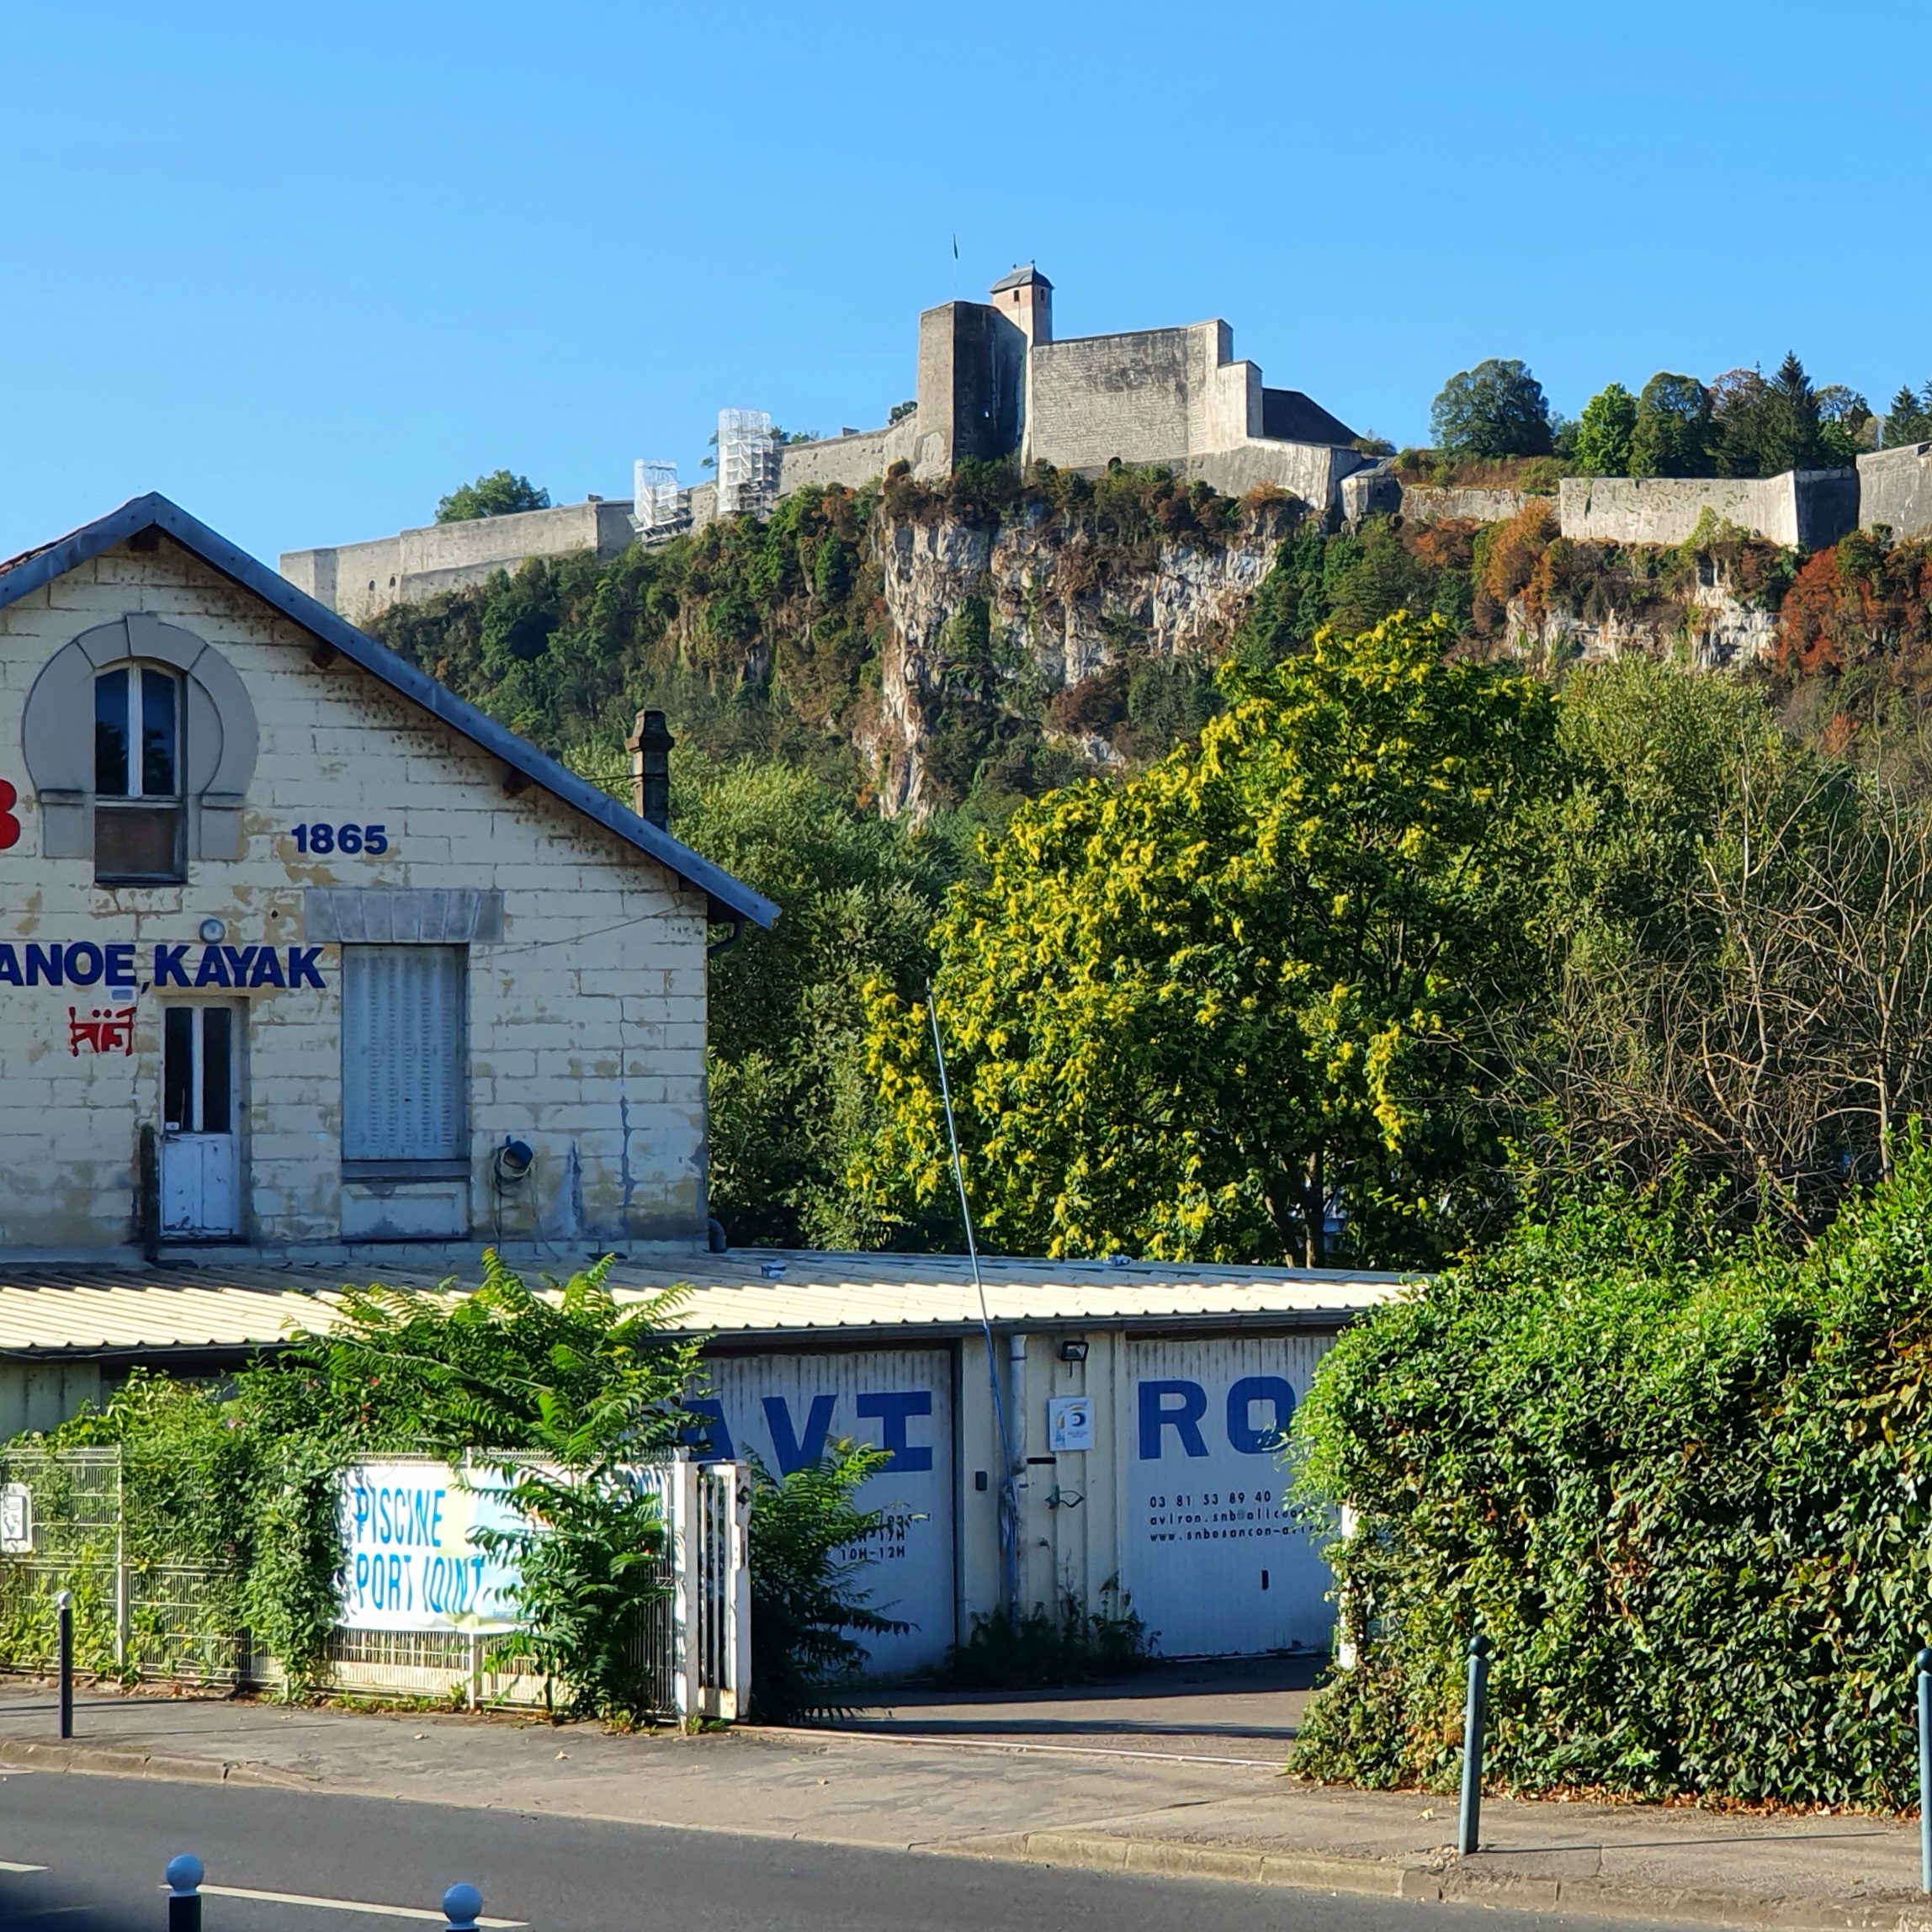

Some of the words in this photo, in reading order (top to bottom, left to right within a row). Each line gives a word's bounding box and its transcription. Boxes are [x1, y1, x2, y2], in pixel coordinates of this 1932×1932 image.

[290, 823, 389, 855] 1865
[678, 1390, 934, 1478] AVI
[355, 1486, 446, 1548] PISCINE
[1149, 1495, 1166, 1509] 03
[1176, 1494, 1192, 1508] 81
[1202, 1493, 1219, 1506] 53
[1229, 1491, 1246, 1505] 89
[1254, 1489, 1272, 1503] 40
[356, 1553, 412, 1612] PORT
